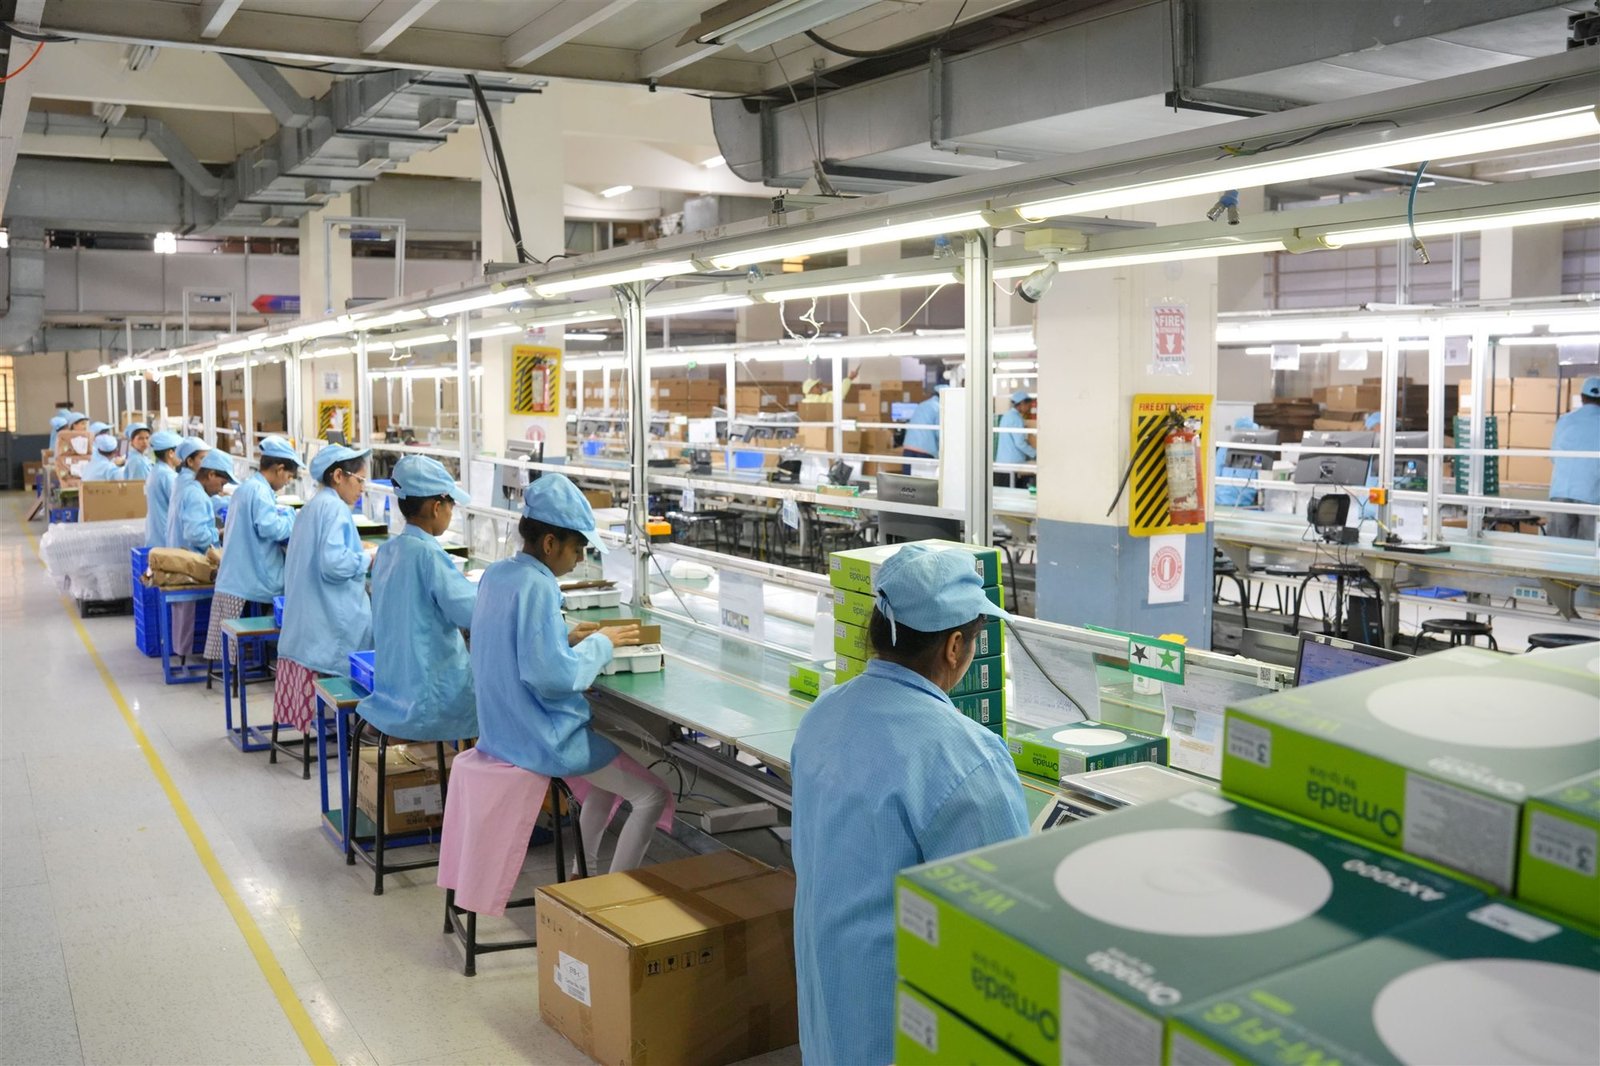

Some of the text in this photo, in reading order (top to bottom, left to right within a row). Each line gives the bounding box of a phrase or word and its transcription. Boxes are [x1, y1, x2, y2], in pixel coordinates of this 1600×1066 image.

[1159, 315, 1181, 327] FIRE
[1139, 402, 1155, 411] FIRE
[1257, 743, 1267, 764] 3
[1032, 757, 1059, 772] Omada
[1305, 780, 1403, 838] Omada
[1341, 858, 1446, 902] AX3000
[970, 966, 1060, 1042] Omada
